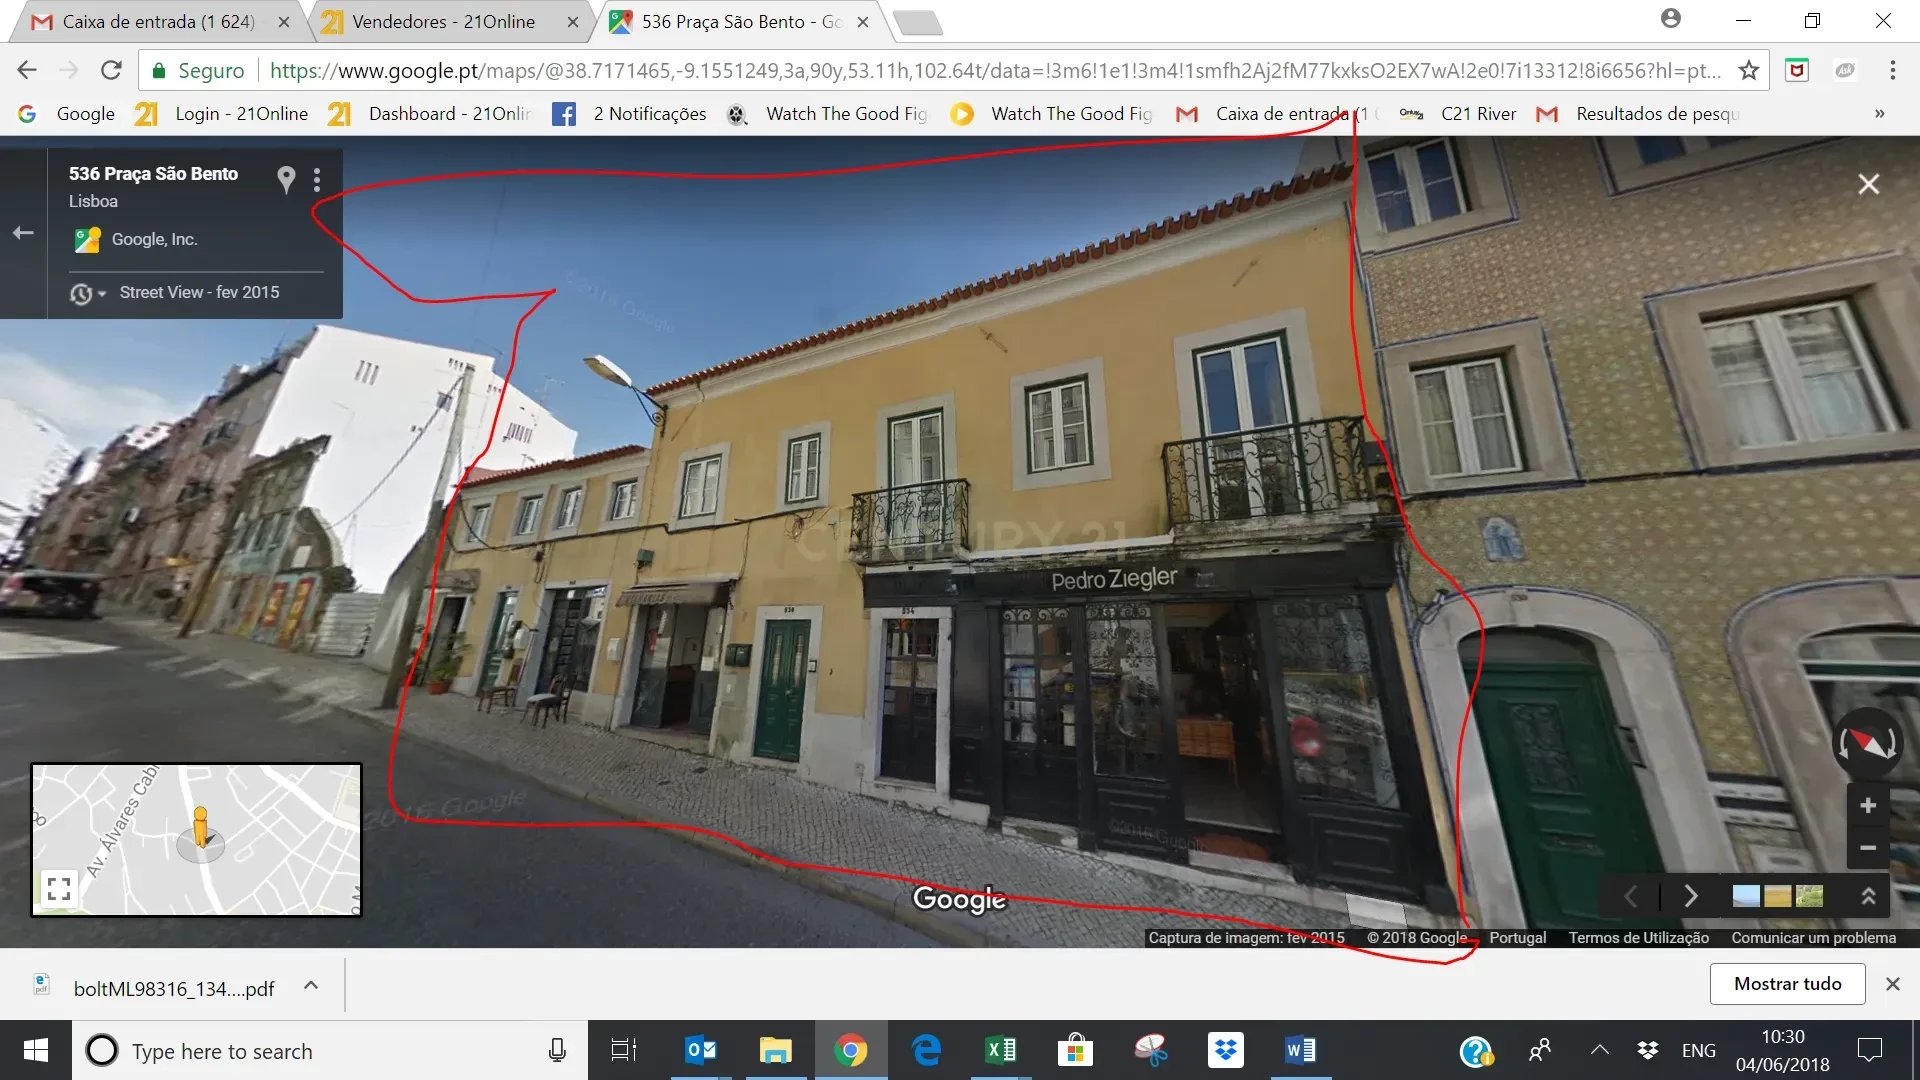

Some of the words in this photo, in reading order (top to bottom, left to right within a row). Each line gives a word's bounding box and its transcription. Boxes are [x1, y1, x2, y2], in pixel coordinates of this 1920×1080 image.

[63, 14, 105, 29] Caixa
[110, 13, 131, 29] de
[135, 13, 196, 29] entrada
[201, 14, 214, 32] (1
[221, 14, 255, 32] 624)
[352, 13, 447, 29] Vendedores
[464, 13, 536, 29] 21Online
[642, 14, 672, 29] 536
[676, 14, 720, 33] Praça
[724, 12, 754, 29] São
[759, 14, 805, 29] Bento
[179, 62, 245, 84] Seguro
[56, 105, 116, 125] Google
[176, 106, 220, 125] Login
[237, 105, 309, 121] 21Online
[369, 105, 456, 121] Dashboard
[594, 106, 604, 121] 2
[609, 105, 707, 125] Notificações
[766, 105, 817, 121] Watch
[820, 105, 851, 121] The
[855, 105, 900, 121] Good
[904, 105, 928, 125] Fig
[991, 105, 1042, 121] Watch
[1045, 105, 1076, 121] The
[1080, 105, 1126, 121] Good
[1129, 105, 1153, 125] Fig
[1216, 105, 1259, 121] Caixa
[1263, 105, 1284, 121] de
[1288, 105, 1350, 121] entrada
[1441, 106, 1470, 121] C21
[1477, 105, 1518, 121] River
[1577, 105, 1663, 121] Resultados
[1667, 105, 1688, 121] de
[68, 166, 101, 181] 536
[104, 166, 152, 185] Praça
[154, 165, 188, 181] São
[190, 166, 239, 181] Bento
[69, 193, 119, 208] Lisboa
[112, 231, 168, 249] Google,
[171, 232, 198, 246] Inc.
[119, 285, 165, 299] Street
[166, 284, 205, 299] View
[215, 284, 239, 299] fev
[242, 285, 280, 299] 2015
[1052, 570, 1106, 591] Pedro
[1108, 566, 1178, 591] Ziegler
[86, 855, 108, 878] Av.
[100, 797, 140, 853] Álvares
[913, 885, 1007, 916] Google
[1148, 931, 1202, 947] Captura
[1205, 931, 1222, 944] de
[1225, 931, 1284, 947] imagem:
[1286, 931, 1308, 944] fev
[1310, 931, 1346, 944] 2015
[1382, 931, 1417, 944] 2018
[1419, 930, 1469, 947] Google
[1490, 930, 1547, 947] Portugal
[1568, 931, 1621, 944] Termos
[1623, 931, 1641, 944] de
[1643, 930, 1710, 947] Utilização
[1731, 931, 1806, 944] Comunicar
[1808, 934, 1830, 944] um
[1833, 930, 1897, 947] problema
[1734, 976, 1800, 991] Mostrar
[1802, 975, 1843, 991] tudo
[1762, 1029, 1806, 1044] 10:30
[131, 1043, 175, 1065] Type
[180, 1042, 223, 1060] here
[227, 1044, 247, 1060] to
[253, 1042, 313, 1060] search
[1682, 1043, 1716, 1058] ENG
[1735, 1057, 1831, 1074] 04/06/2018
